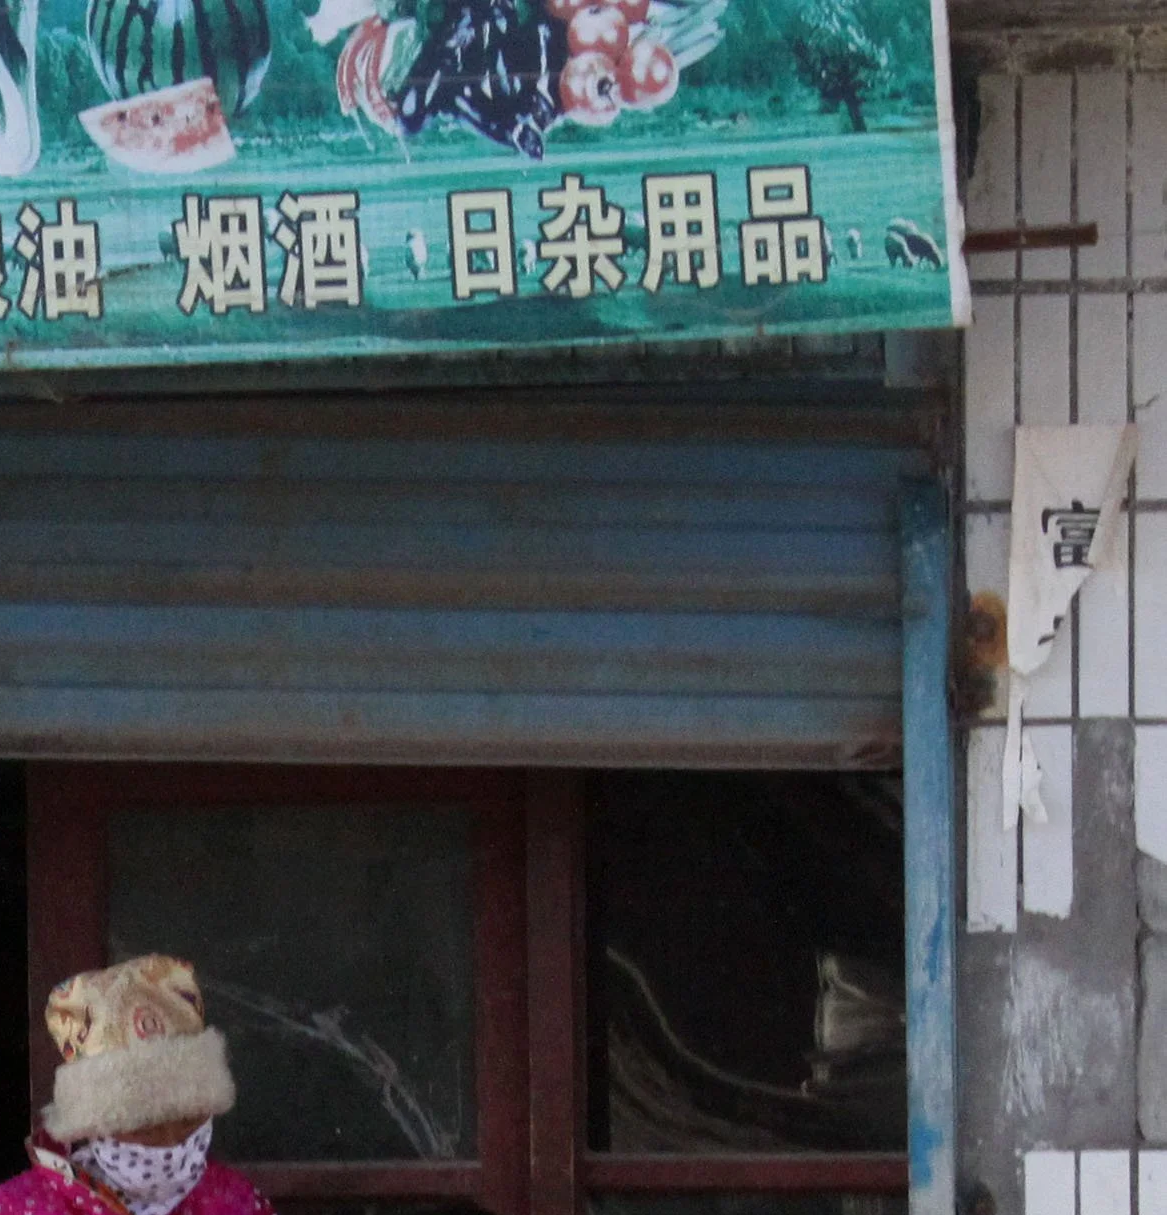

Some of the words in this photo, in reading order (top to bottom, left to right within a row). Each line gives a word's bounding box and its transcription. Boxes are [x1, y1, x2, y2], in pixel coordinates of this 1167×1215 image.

[172, 189, 364, 316] 烟酒
[447, 163, 827, 300] 日杂用品
